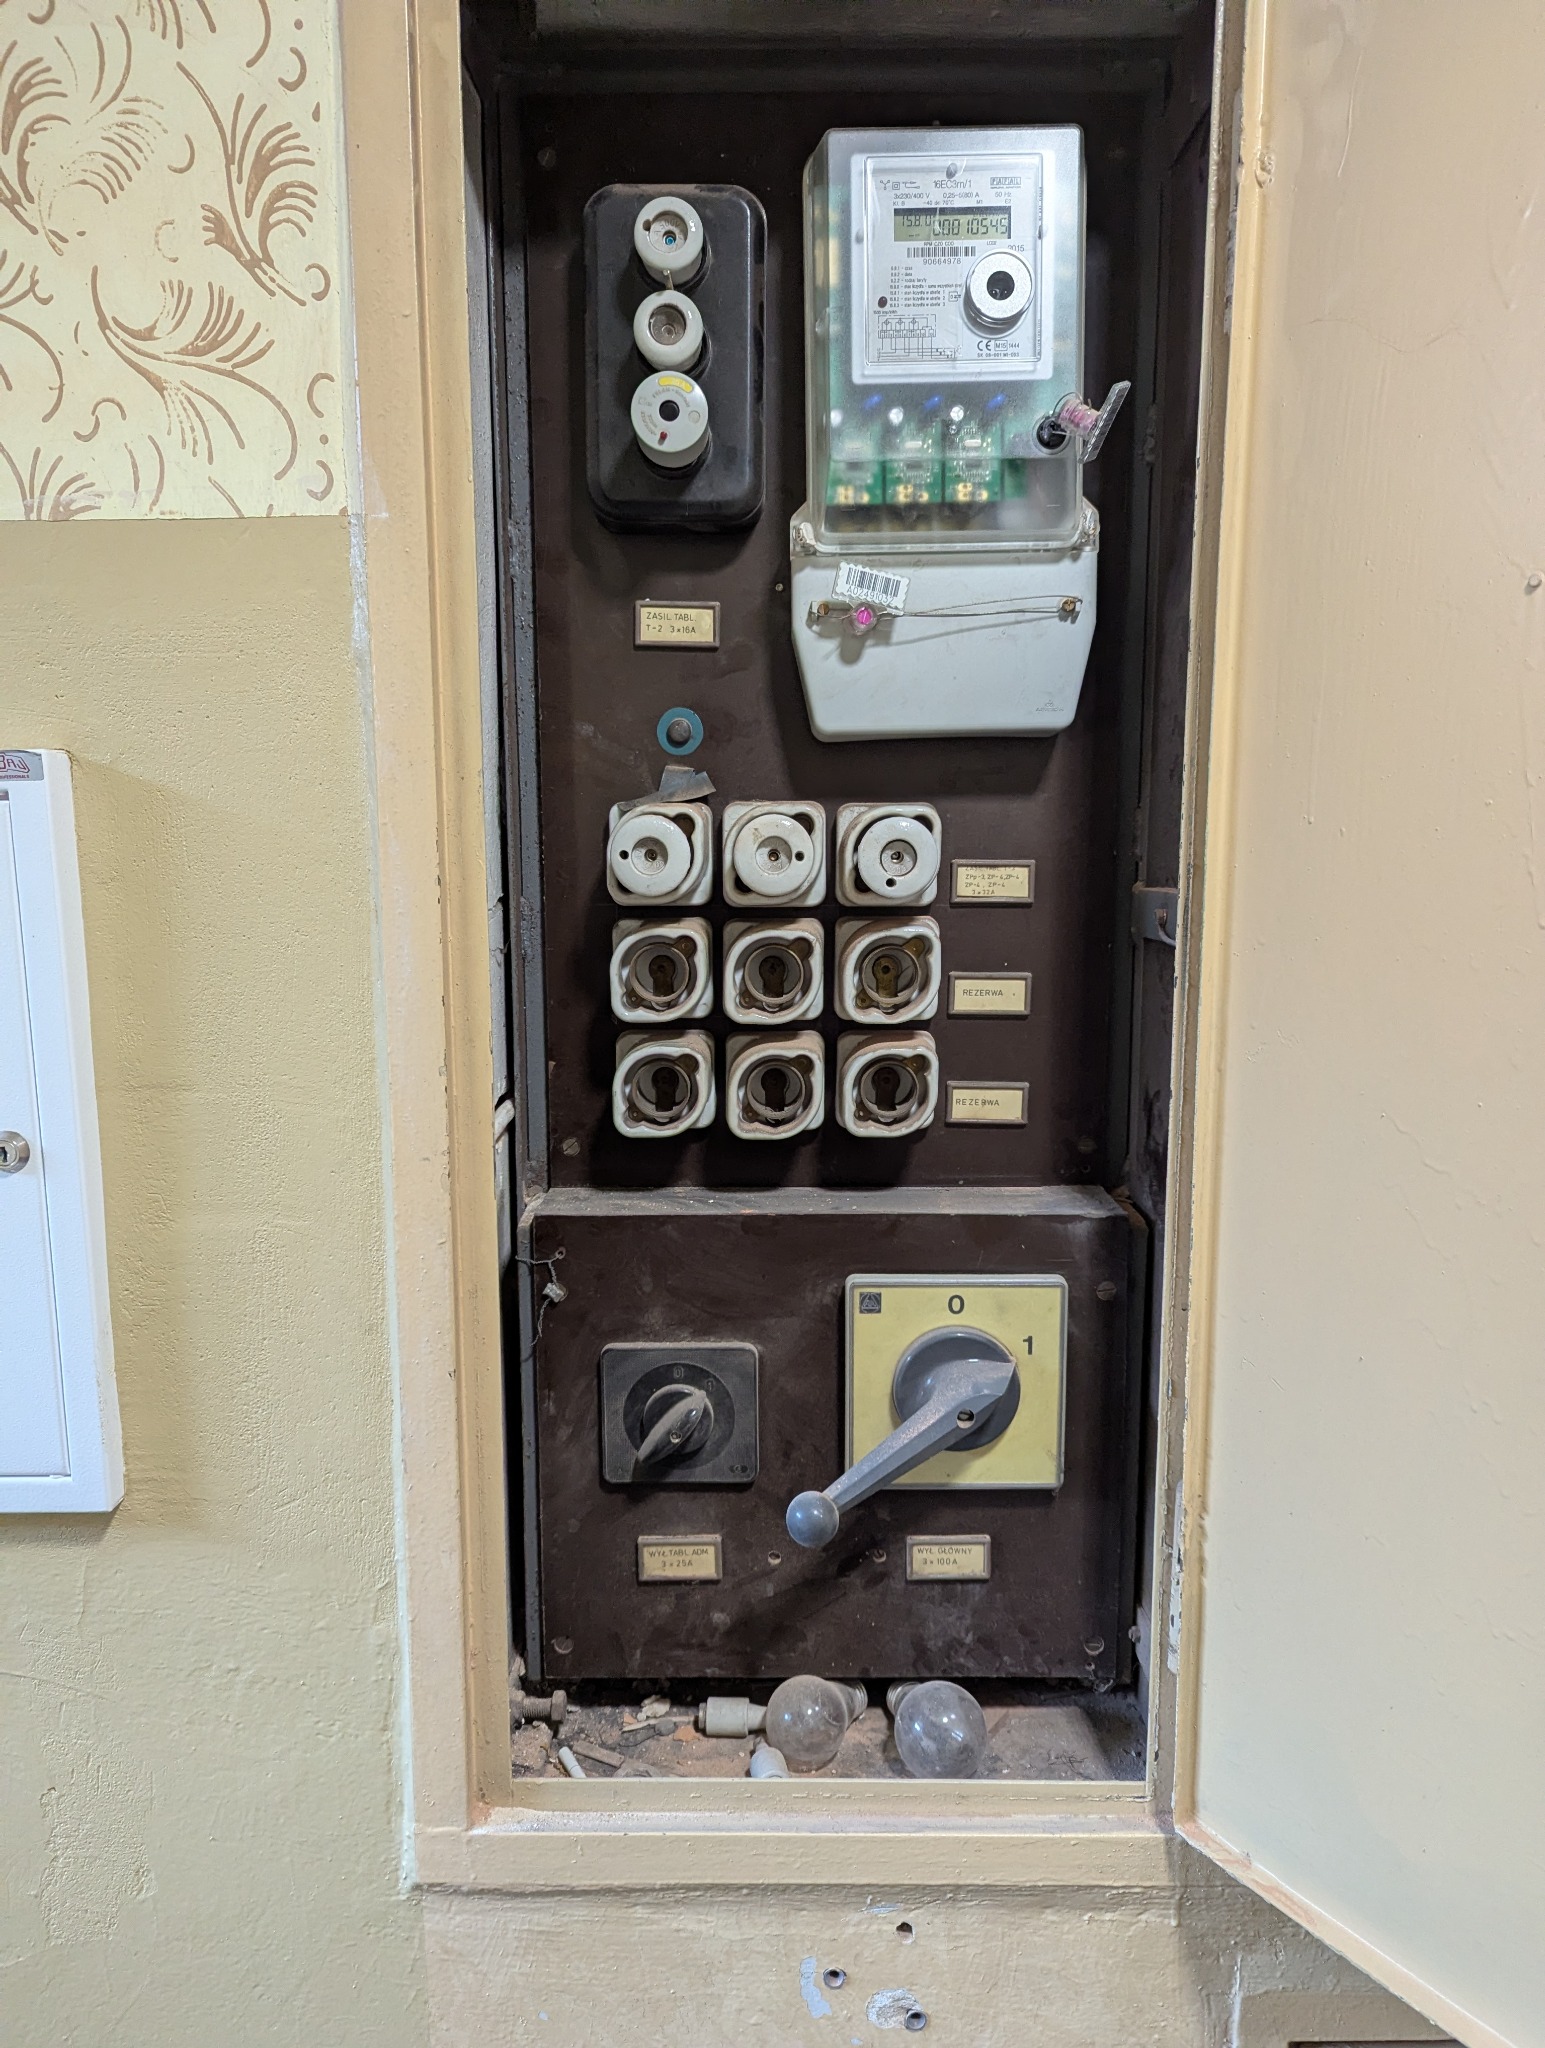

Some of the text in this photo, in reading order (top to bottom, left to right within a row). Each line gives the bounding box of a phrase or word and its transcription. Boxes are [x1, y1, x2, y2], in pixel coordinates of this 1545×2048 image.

[948, 1295, 965, 1314] 0
[1022, 1336, 1033, 1355] 1
[673, 1365, 684, 1379] 0
